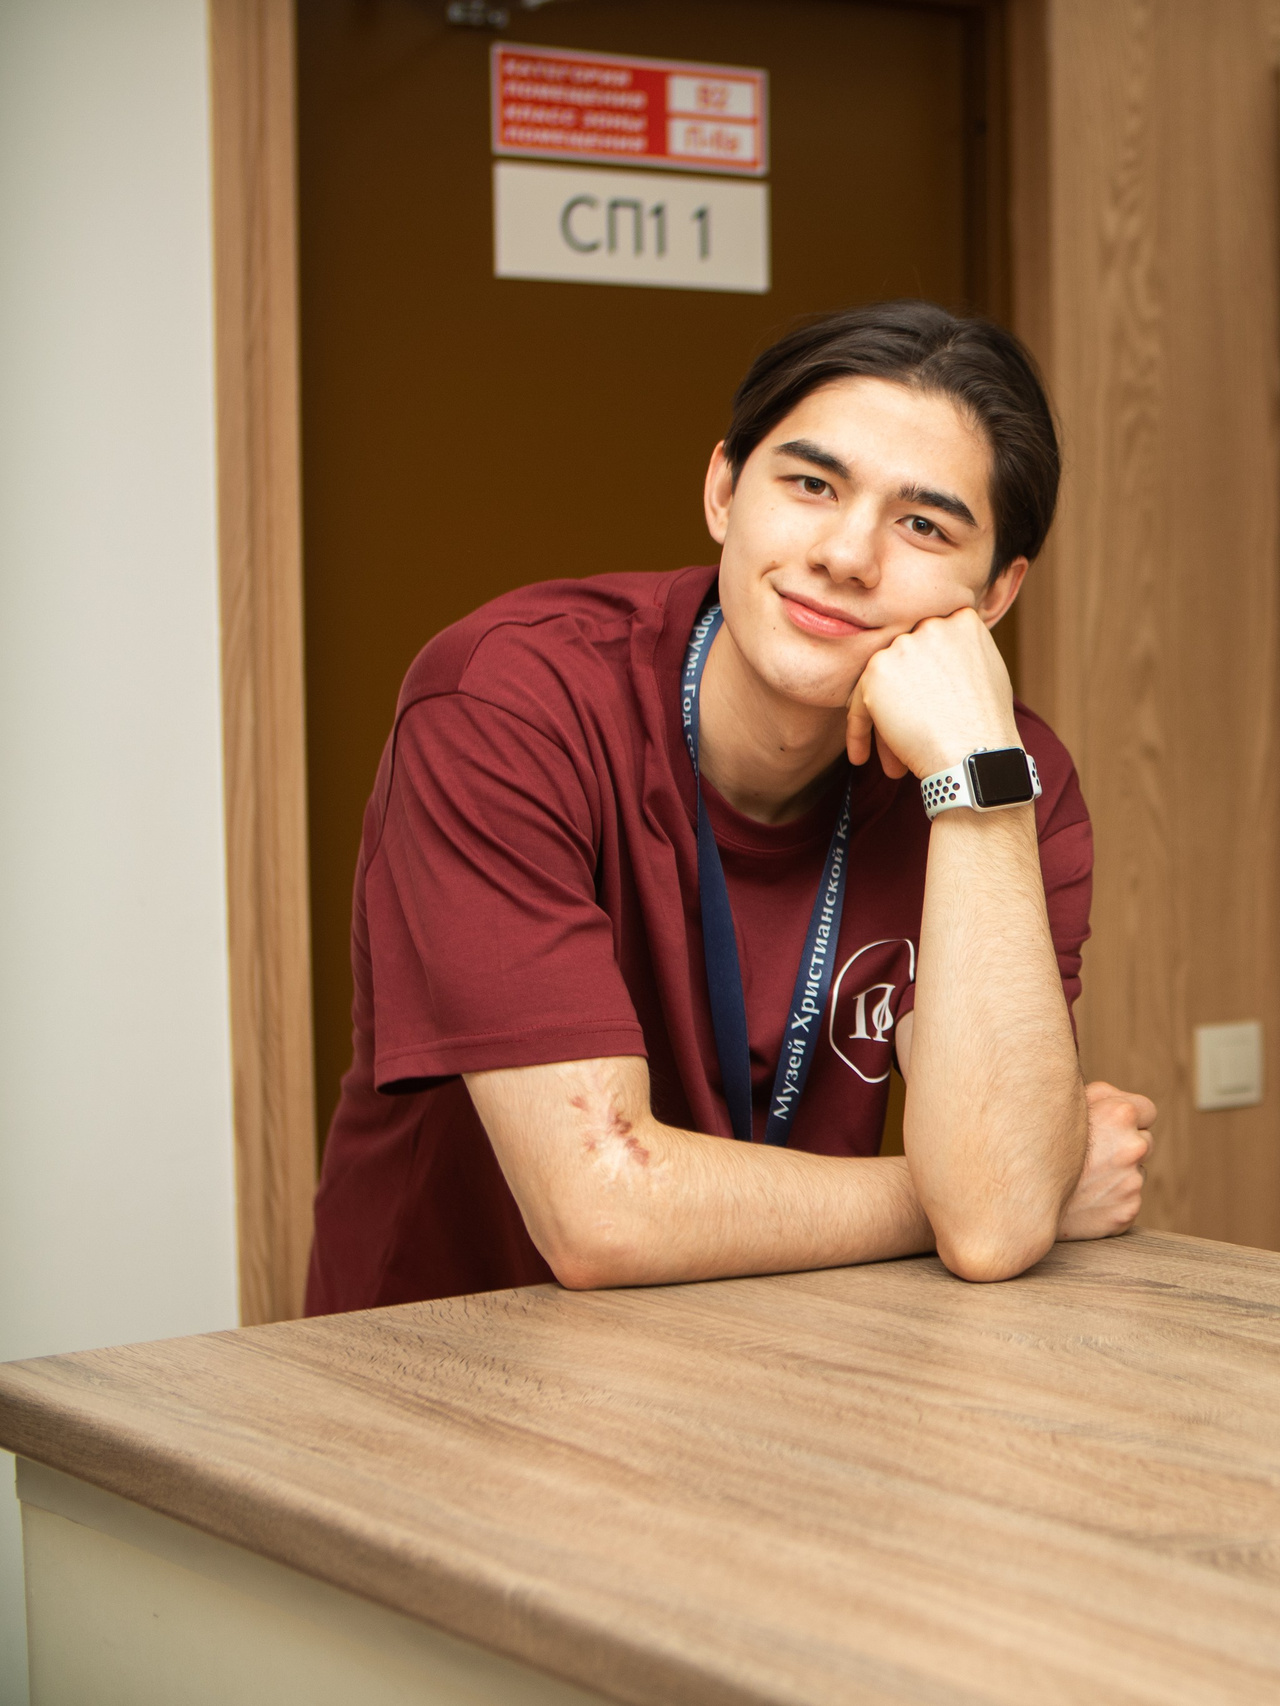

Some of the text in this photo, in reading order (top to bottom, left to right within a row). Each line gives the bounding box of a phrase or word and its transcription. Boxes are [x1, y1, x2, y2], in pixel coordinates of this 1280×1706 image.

[559, 195, 711, 260] СП1 1
[683, 683, 697, 727] Год
[773, 1038, 807, 1120] Музей
[791, 847, 844, 1033] Христианской
